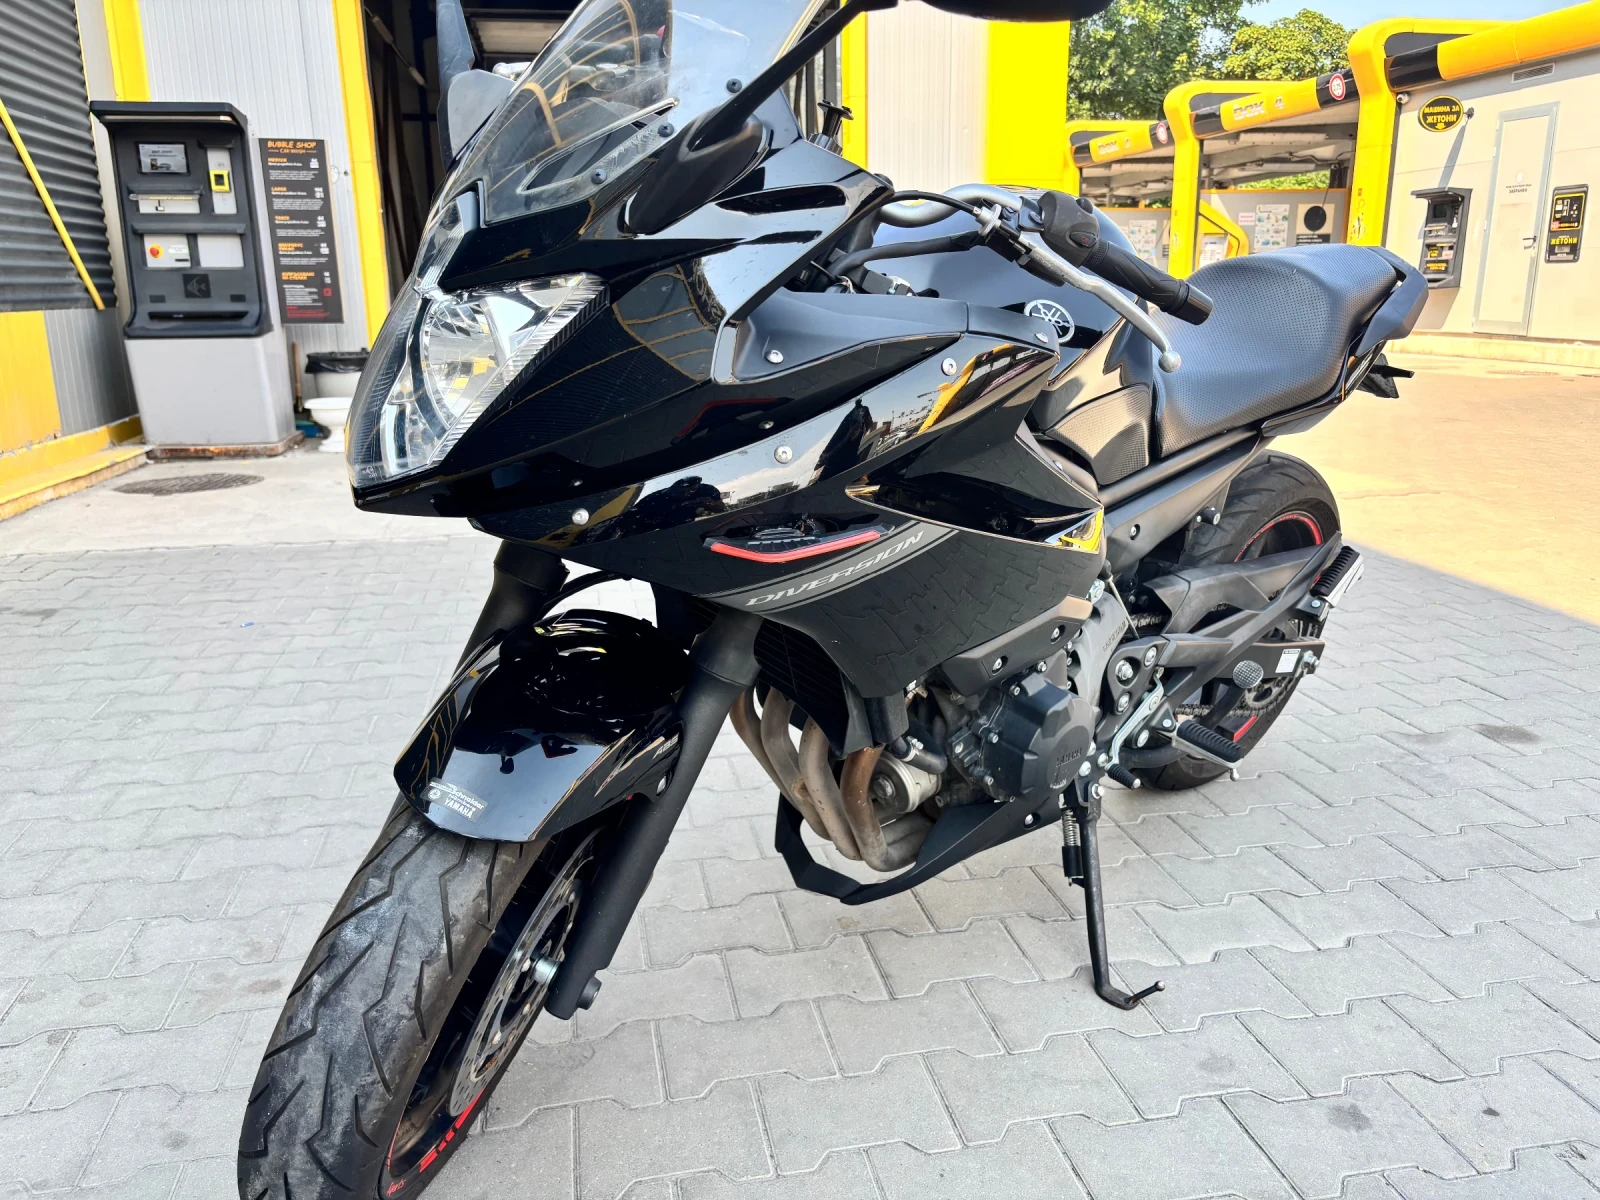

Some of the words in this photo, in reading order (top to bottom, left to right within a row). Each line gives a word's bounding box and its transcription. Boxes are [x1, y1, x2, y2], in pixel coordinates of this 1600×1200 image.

[1274, 95, 1285, 110] 4
[1424, 105, 1450, 113] МАШИНА
[1427, 114, 1457, 123] ЖЕТОНИ
[267, 141, 294, 149] BUBBLE
[296, 141, 316, 149] SHOP
[1550, 237, 1578, 245] ЖЕТОНИ
[745, 530, 925, 607] DIVERSION
[445, 798, 474, 818] YAMAHA
